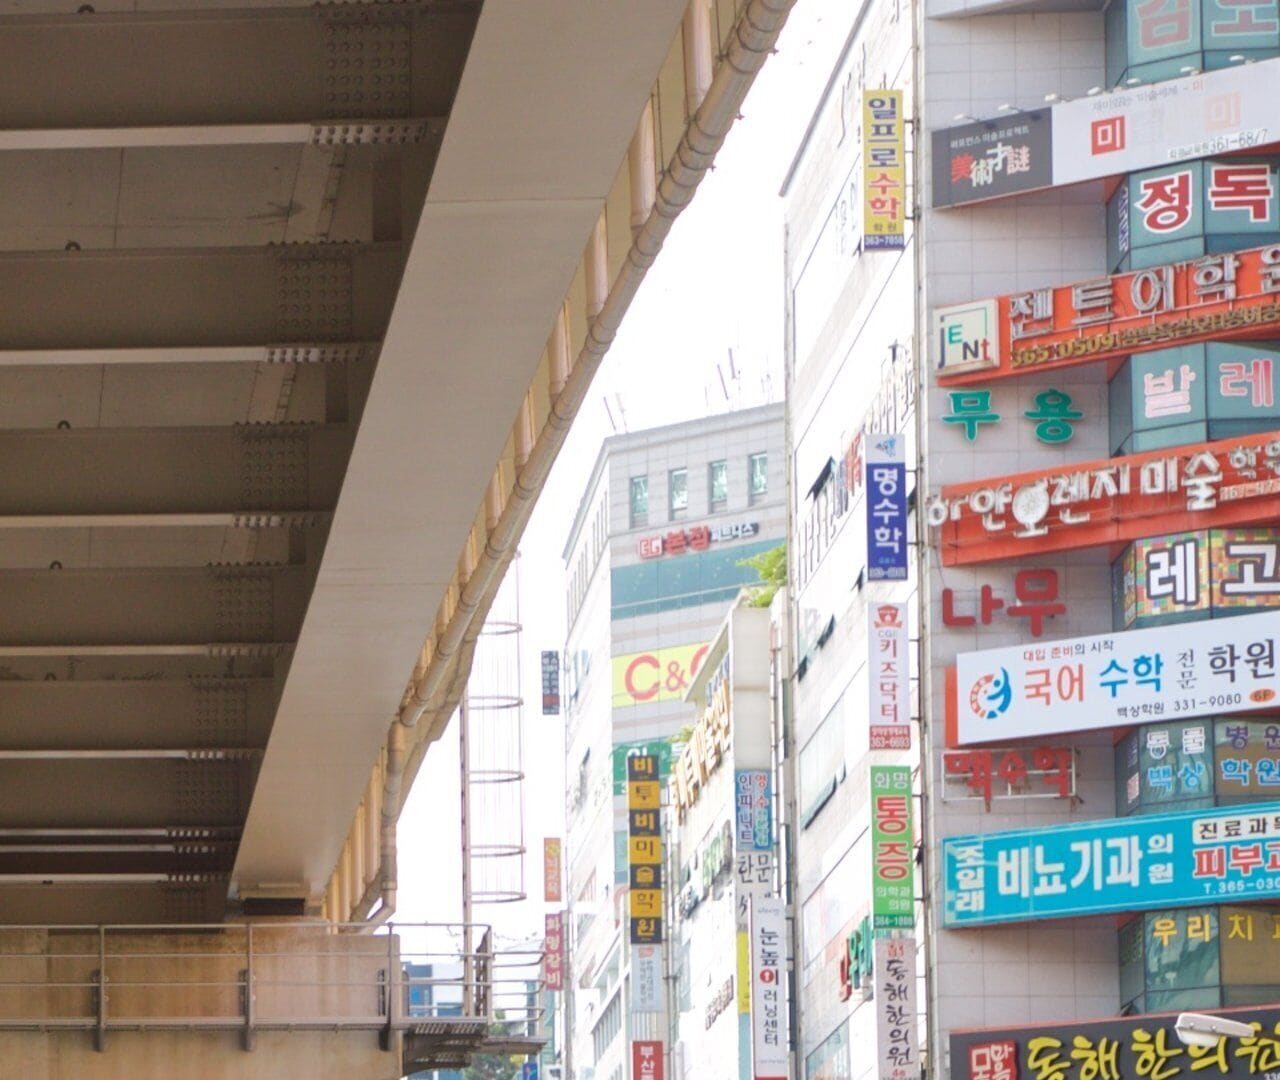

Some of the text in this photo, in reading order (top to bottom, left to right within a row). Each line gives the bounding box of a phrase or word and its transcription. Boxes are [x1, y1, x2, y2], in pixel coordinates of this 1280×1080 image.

[867, 97, 901, 221] 일프로수학
[1096, 124, 1122, 150] 미
[1135, 164, 1274, 235] 정독
[942, 388, 1083, 443] 무용
[1143, 359, 1275, 418] 발레
[873, 467, 903, 554] 명수학
[1140, 451, 1223, 511] 미술
[942, 568, 1067, 638] 나무
[1148, 539, 1280, 606] 레고
[879, 638, 899, 723] 키즈닥터
[1023, 639, 1115, 662] 대입 준비의 시작
[1023, 638, 1276, 707] 국어 수학 전문 학원
[1116, 693, 1243, 718] 백상학원 331-9080
[874, 770, 909, 790] 화명
[876, 795, 911, 881] 통증
[997, 834, 1144, 899] 비뇨기과
[1147, 832, 1175, 885] 의원
[759, 926, 779, 986] 눈높이
[762, 989, 779, 1046] 러닝센터
[883, 960, 915, 1066] 동해한의원
